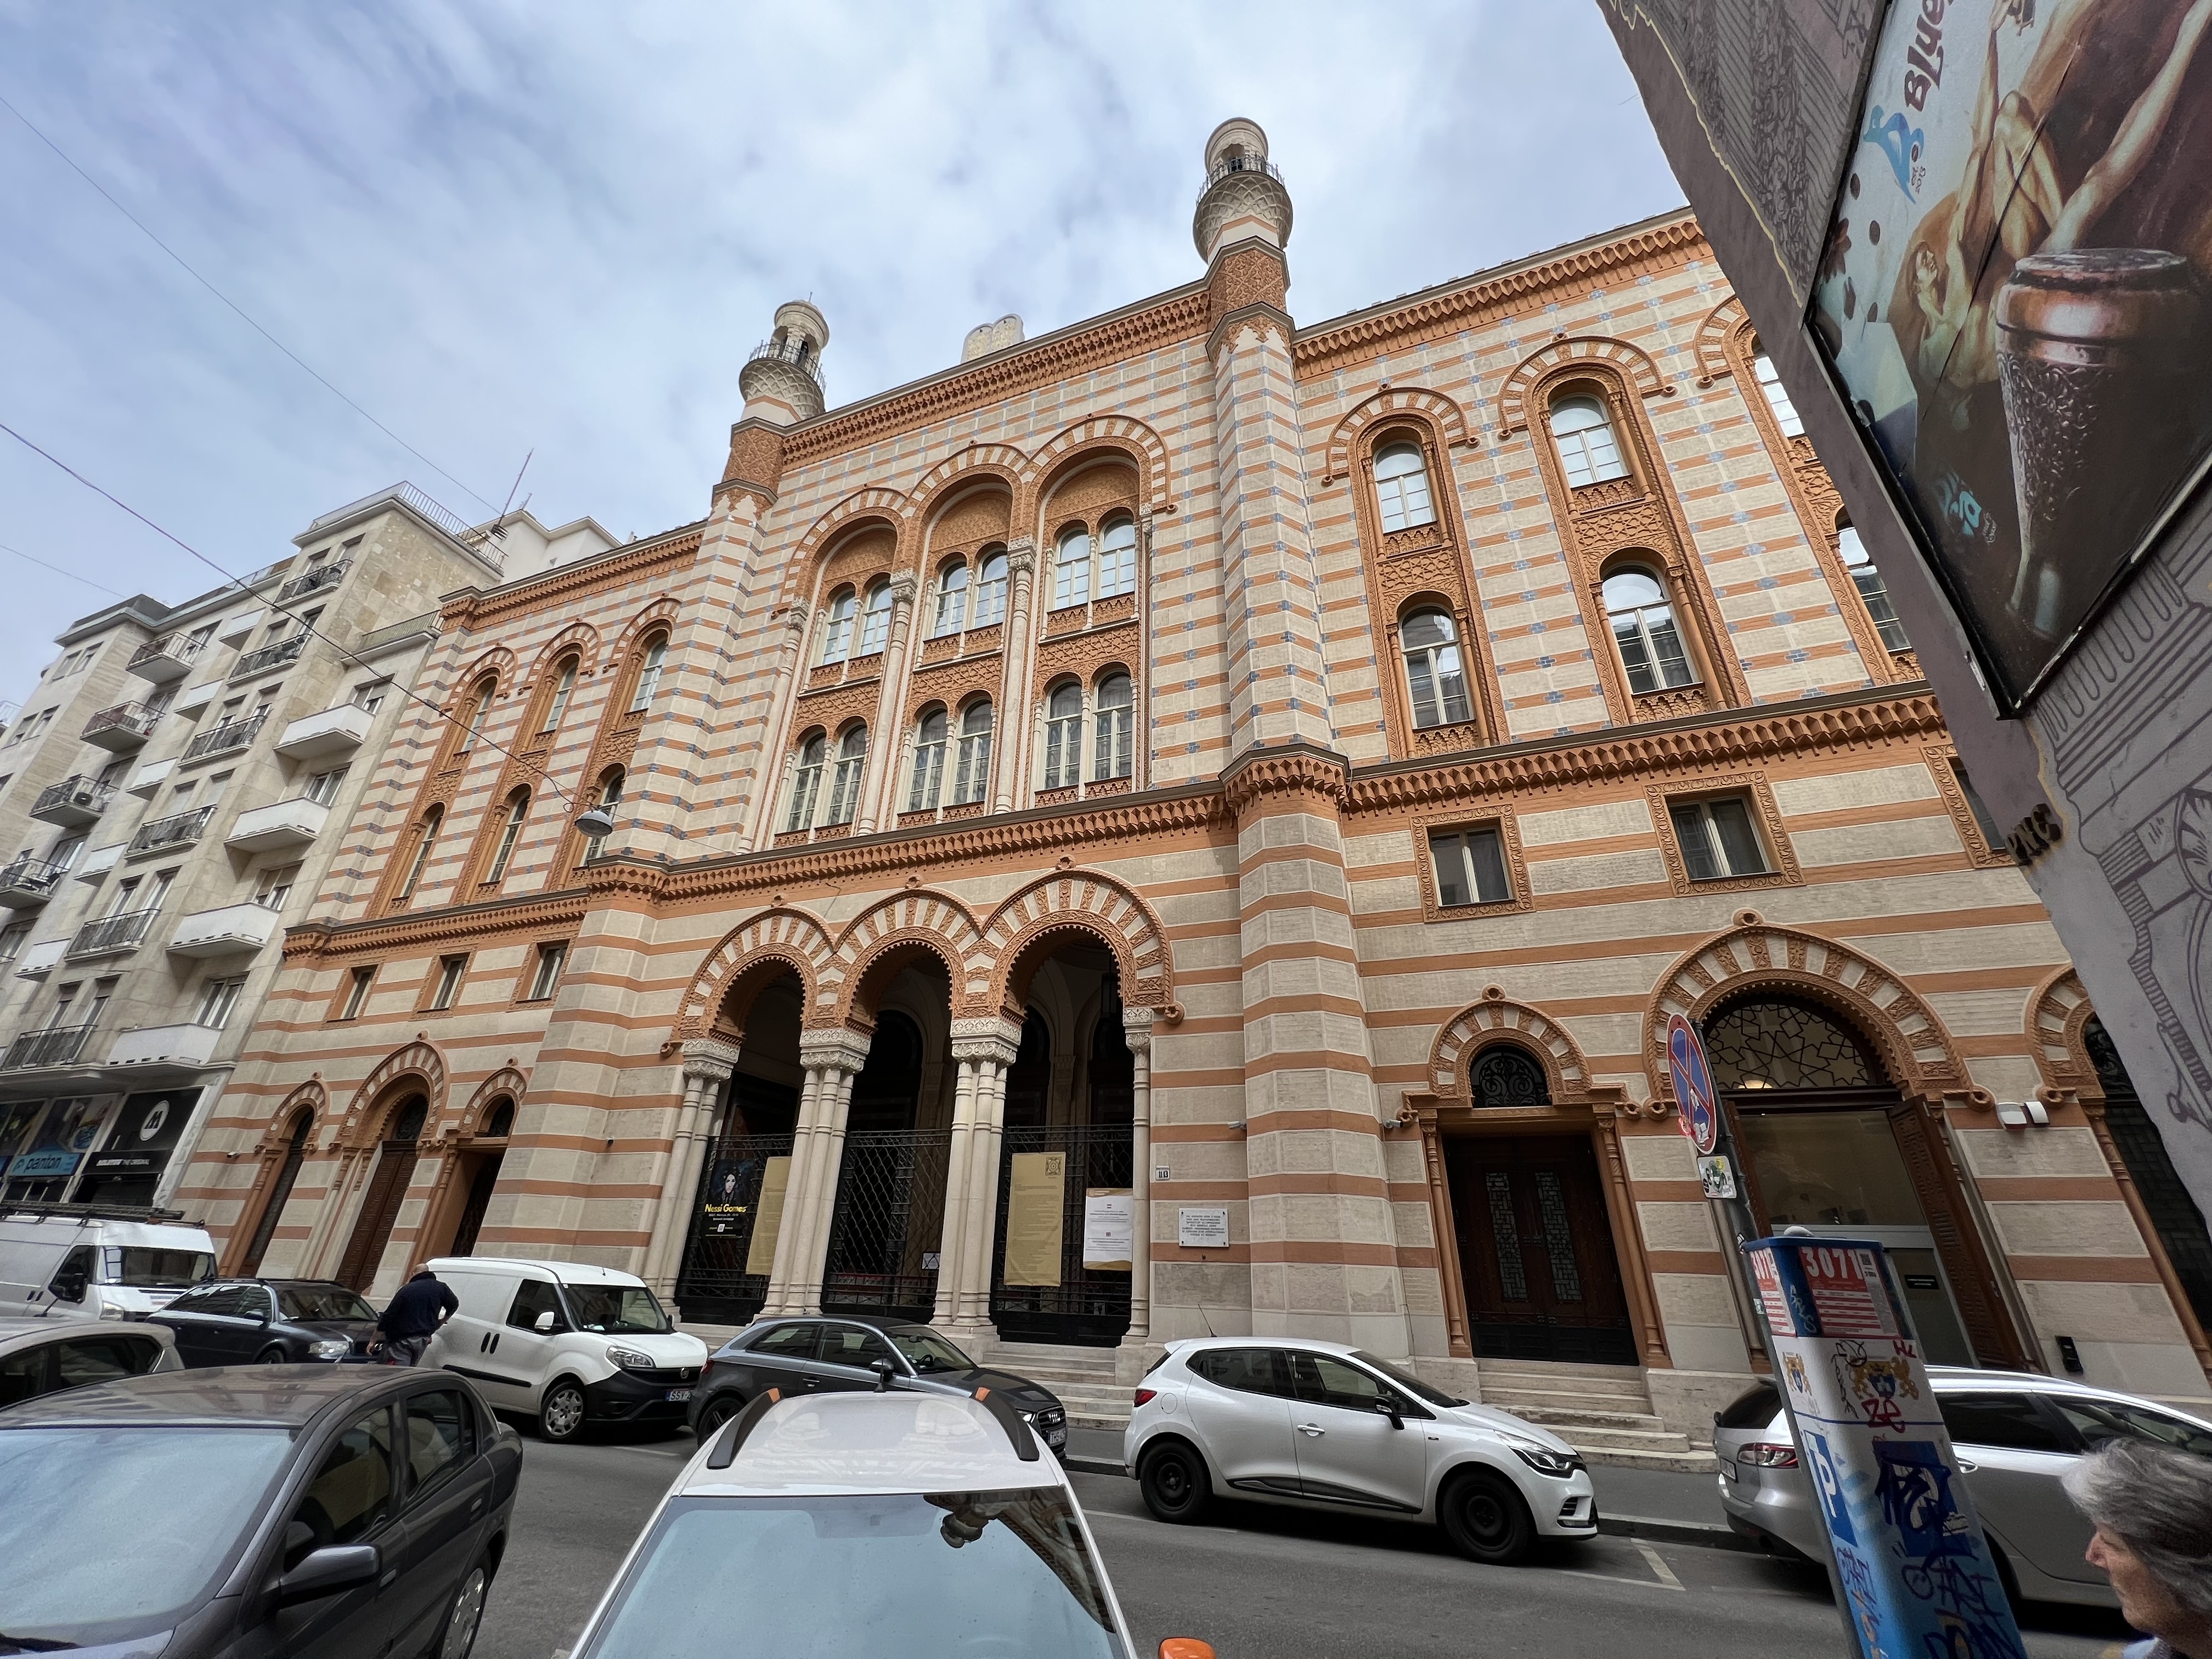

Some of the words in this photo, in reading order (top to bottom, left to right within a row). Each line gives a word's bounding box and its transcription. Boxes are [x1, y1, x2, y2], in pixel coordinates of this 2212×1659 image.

[23, 1154, 62, 1173] panton
[704, 1203, 723, 1212] Nessi
[723, 1203, 747, 1212] Gomes
[1801, 1246, 1863, 1280] 3071
